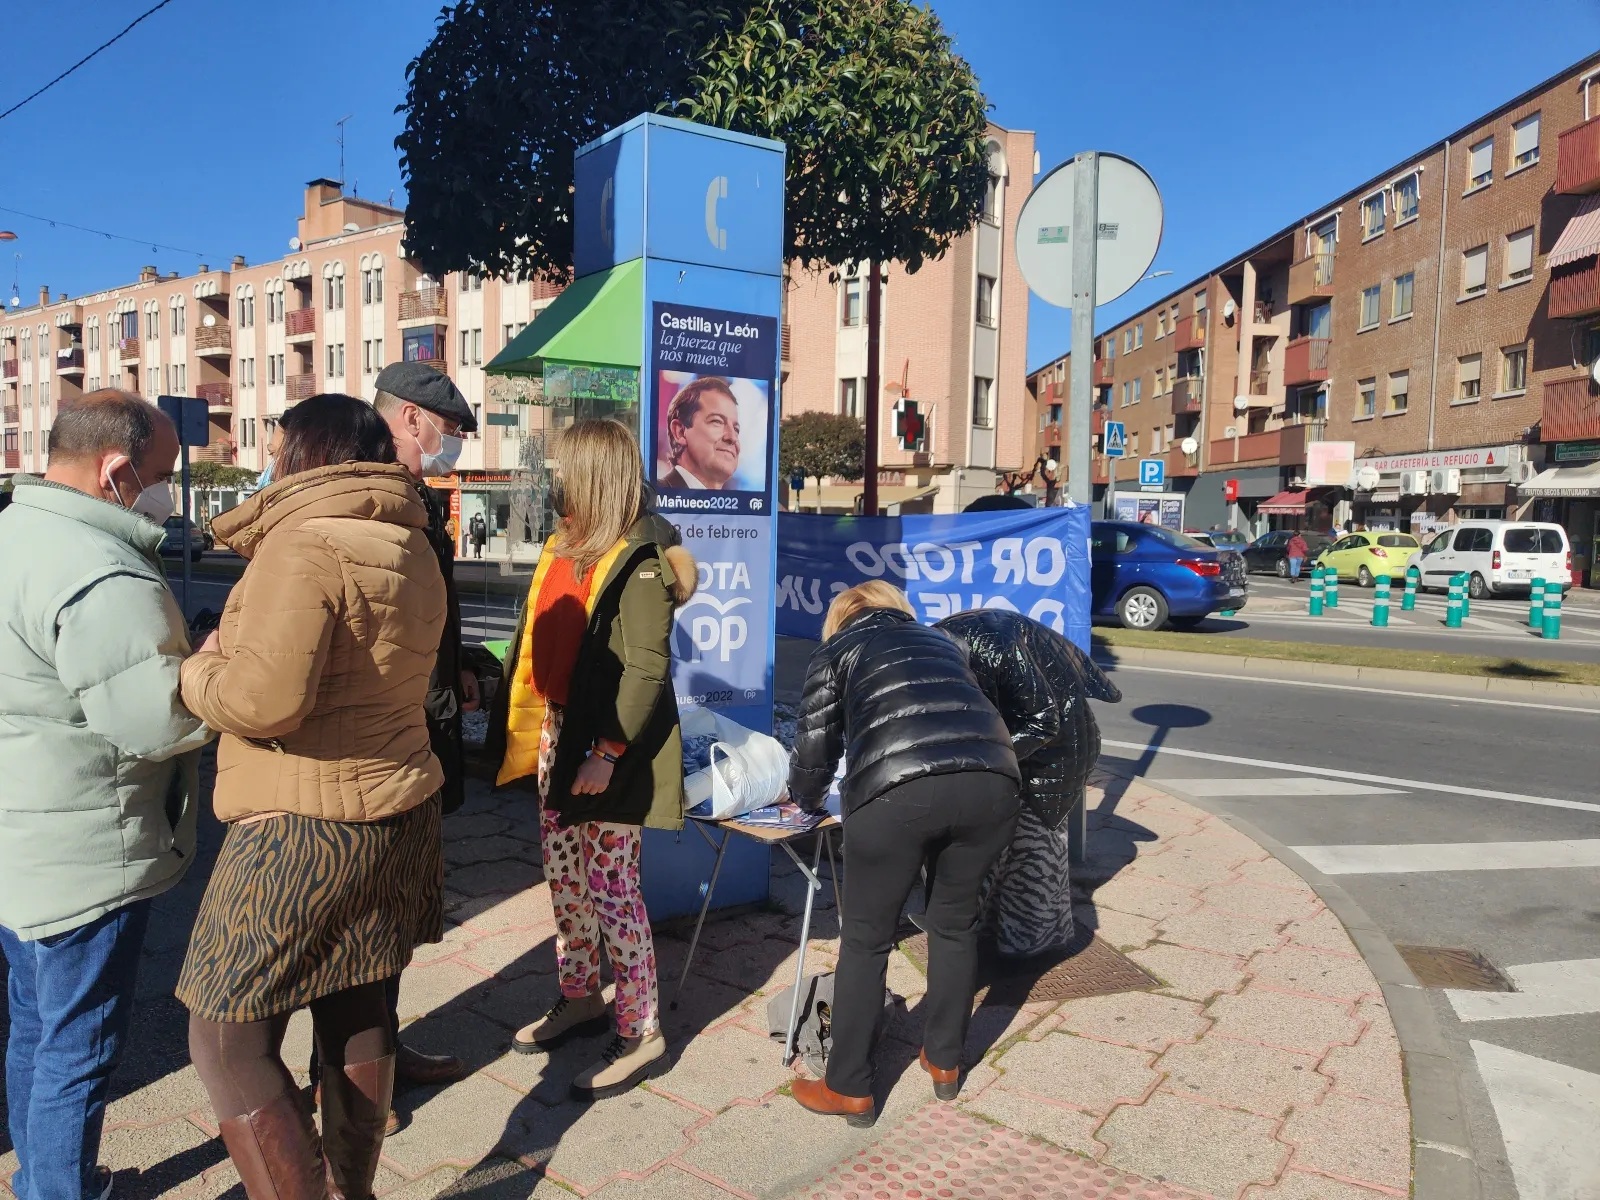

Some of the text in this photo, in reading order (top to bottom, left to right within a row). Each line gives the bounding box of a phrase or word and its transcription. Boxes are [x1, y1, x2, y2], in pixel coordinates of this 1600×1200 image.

[660, 312, 759, 339] Castilla y León
[660, 330, 742, 355] la fuerza que
[659, 349, 729, 367] nos mueve.
[1374, 460, 1388, 470] BAR
[1431, 456, 1440, 467] EL
[1443, 453, 1479, 466] REFUGIO
[1145, 462, 1159, 481] P
[1544, 488, 1560, 496] SECOS
[656, 494, 739, 510] Mañueco2022
[686, 524, 704, 539] de
[707, 524, 758, 539] febrero
[697, 562, 751, 590] OTA
[692, 615, 748, 663] pp
[675, 690, 733, 705] ñueco2022
